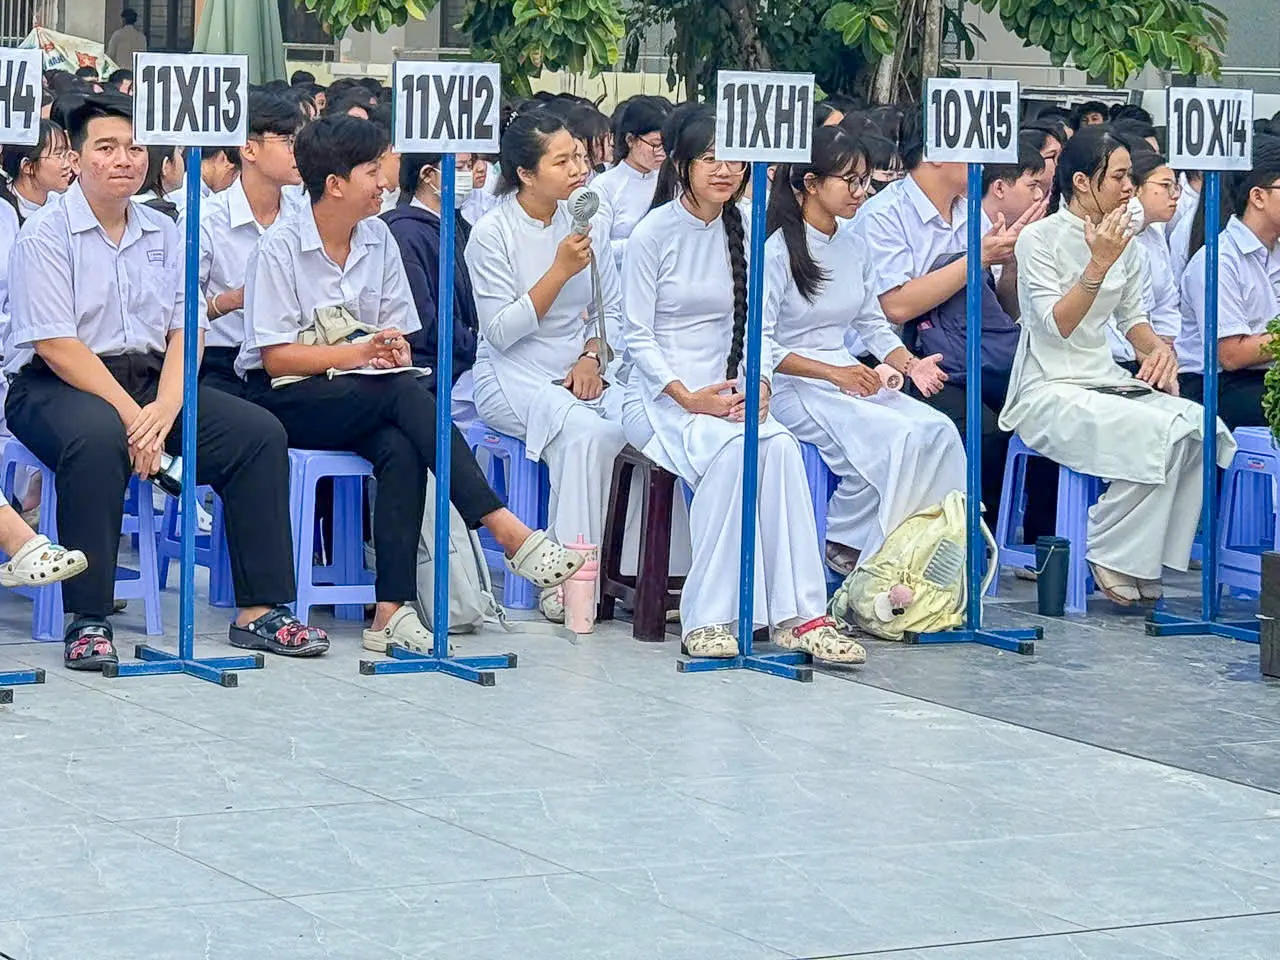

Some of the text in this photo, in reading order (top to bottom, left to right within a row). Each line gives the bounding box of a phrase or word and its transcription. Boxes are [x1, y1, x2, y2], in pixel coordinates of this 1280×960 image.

[142, 66, 241, 132] 11XH3
[402, 75, 493, 139] 11XH2
[723, 84, 808, 149] 11XH1
[931, 89, 1012, 149] 10XH5
[1174, 98, 1246, 157] 10XH4
